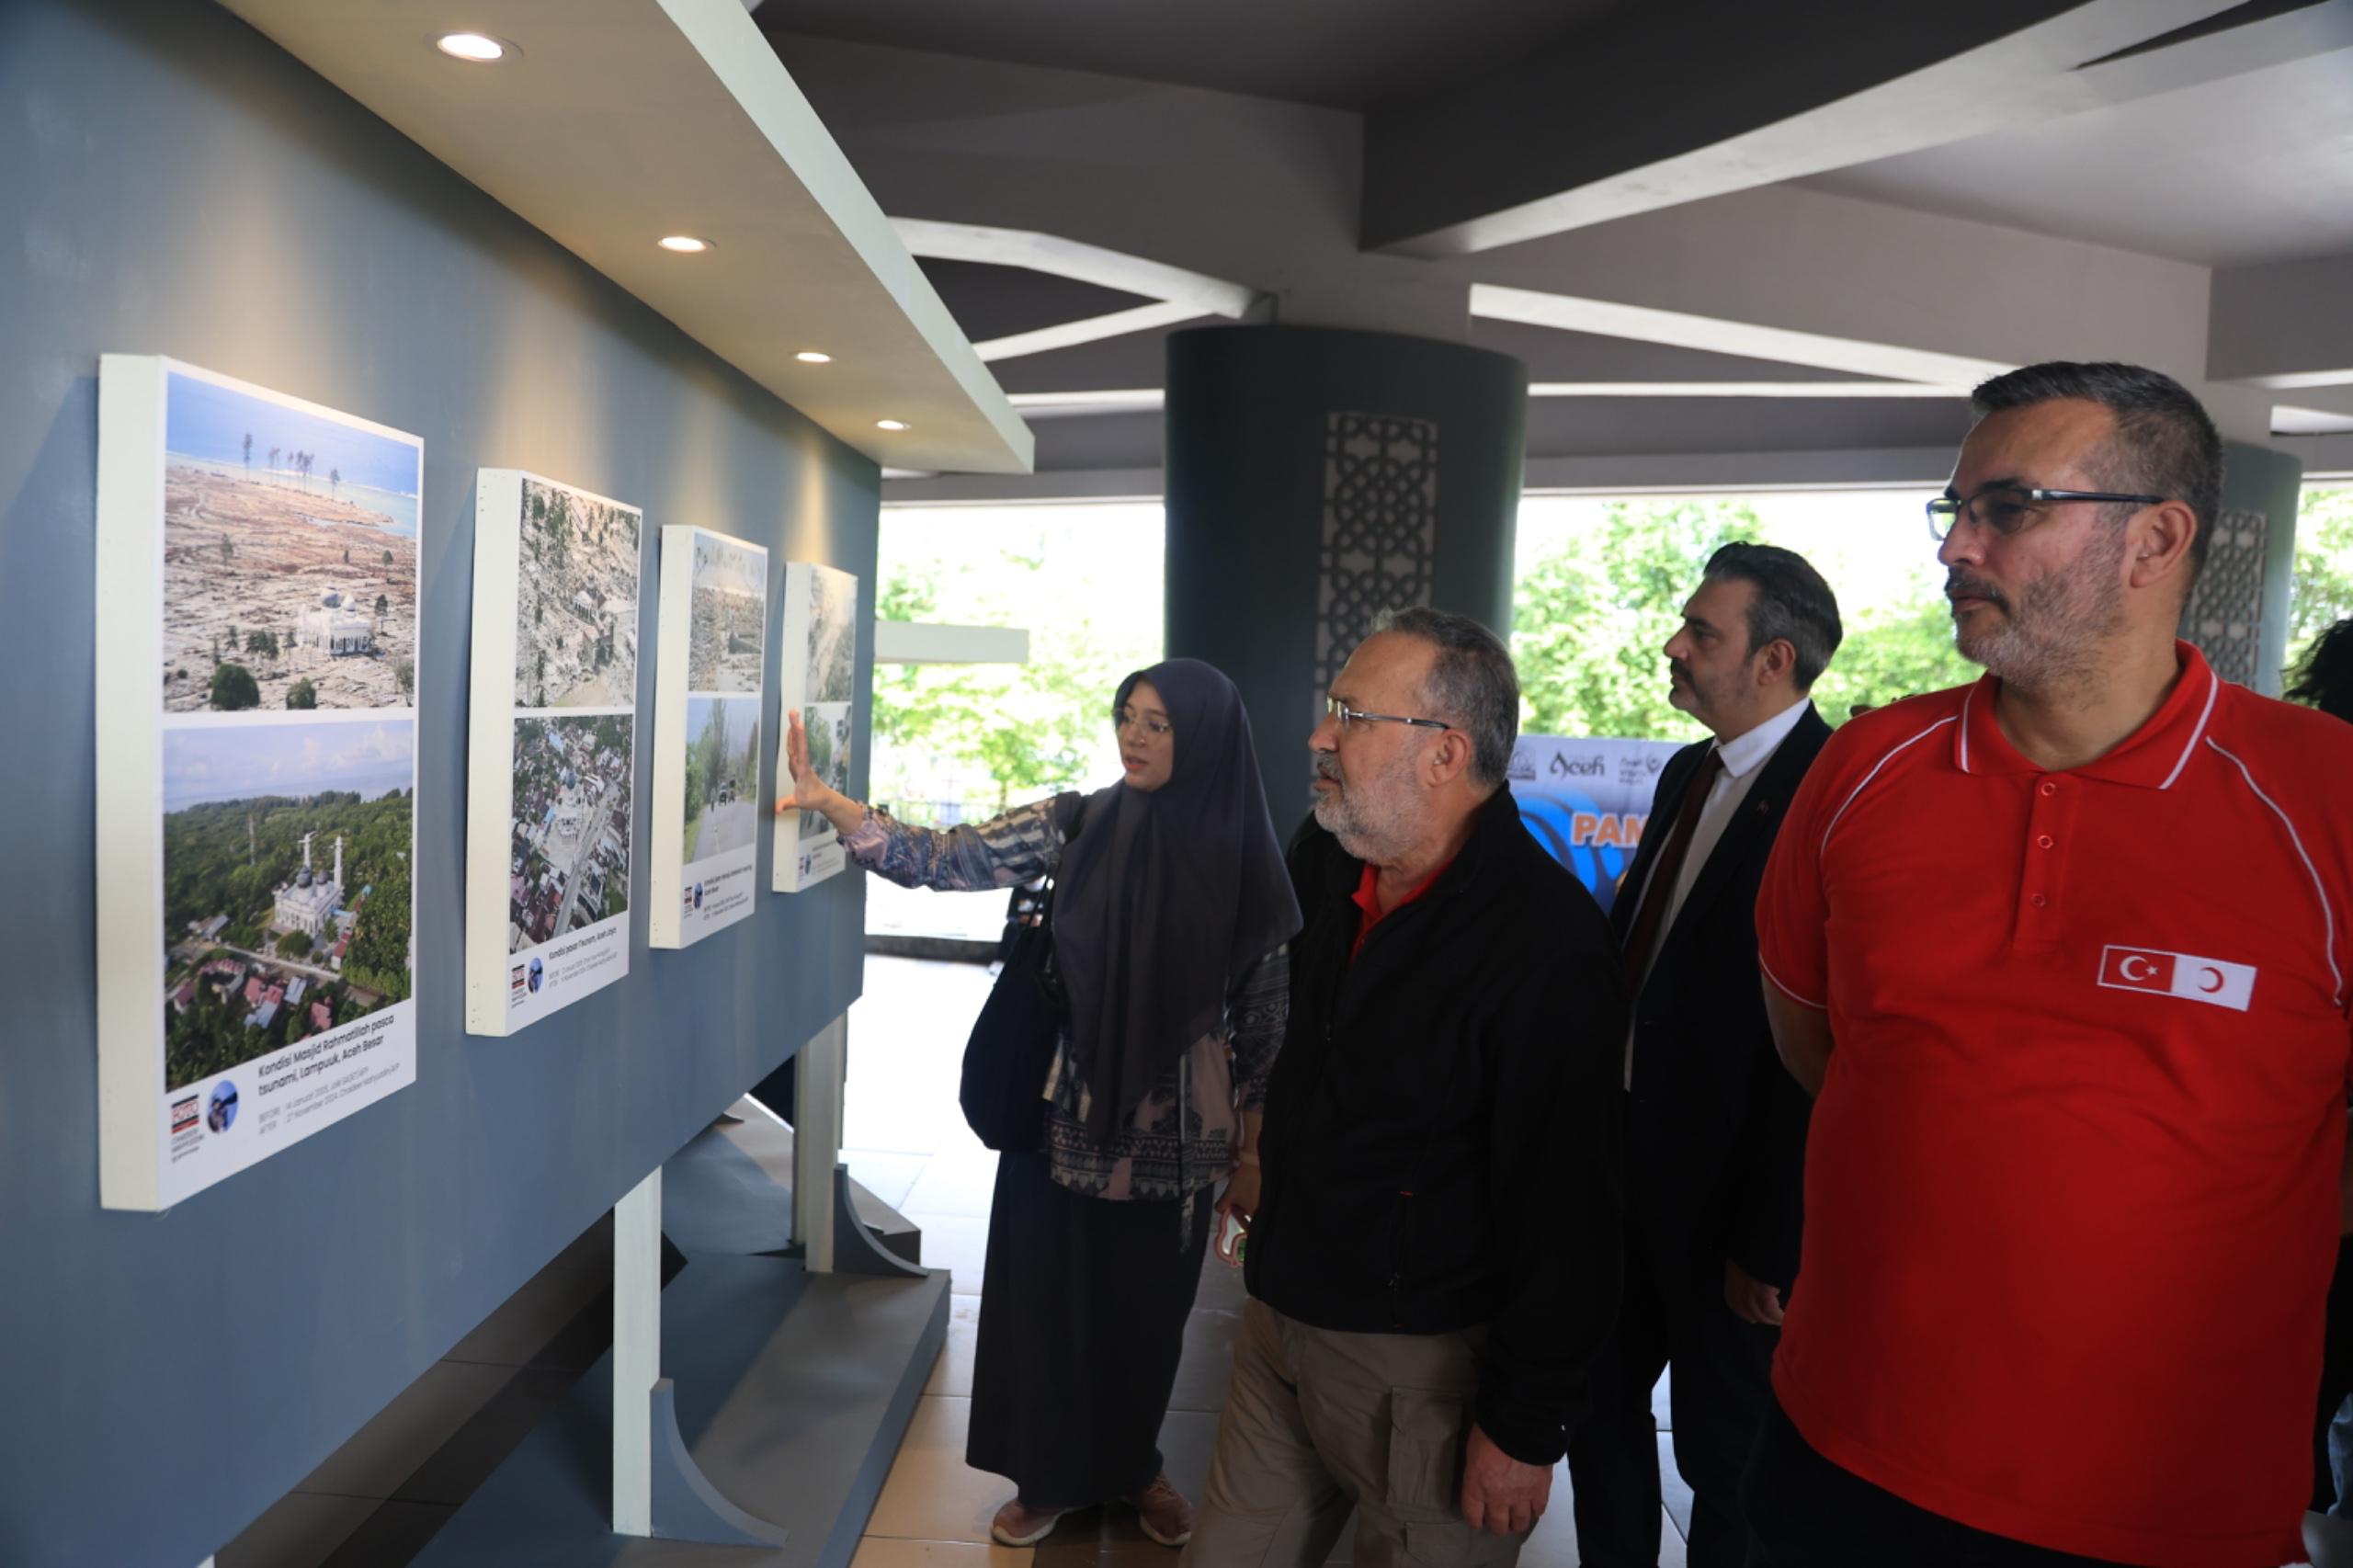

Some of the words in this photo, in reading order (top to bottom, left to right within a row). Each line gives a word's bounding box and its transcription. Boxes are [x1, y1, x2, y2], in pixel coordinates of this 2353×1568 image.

[258, 1053, 292, 1077] Kondisi
[293, 1042, 322, 1062] Masjid
[323, 1024, 370, 1051] Rahmatillah
[371, 1015, 395, 1034] pasca
[258, 1072, 299, 1096] tsunami,
[342, 1044, 362, 1059] Aceh
[363, 1035, 384, 1051] Besar
